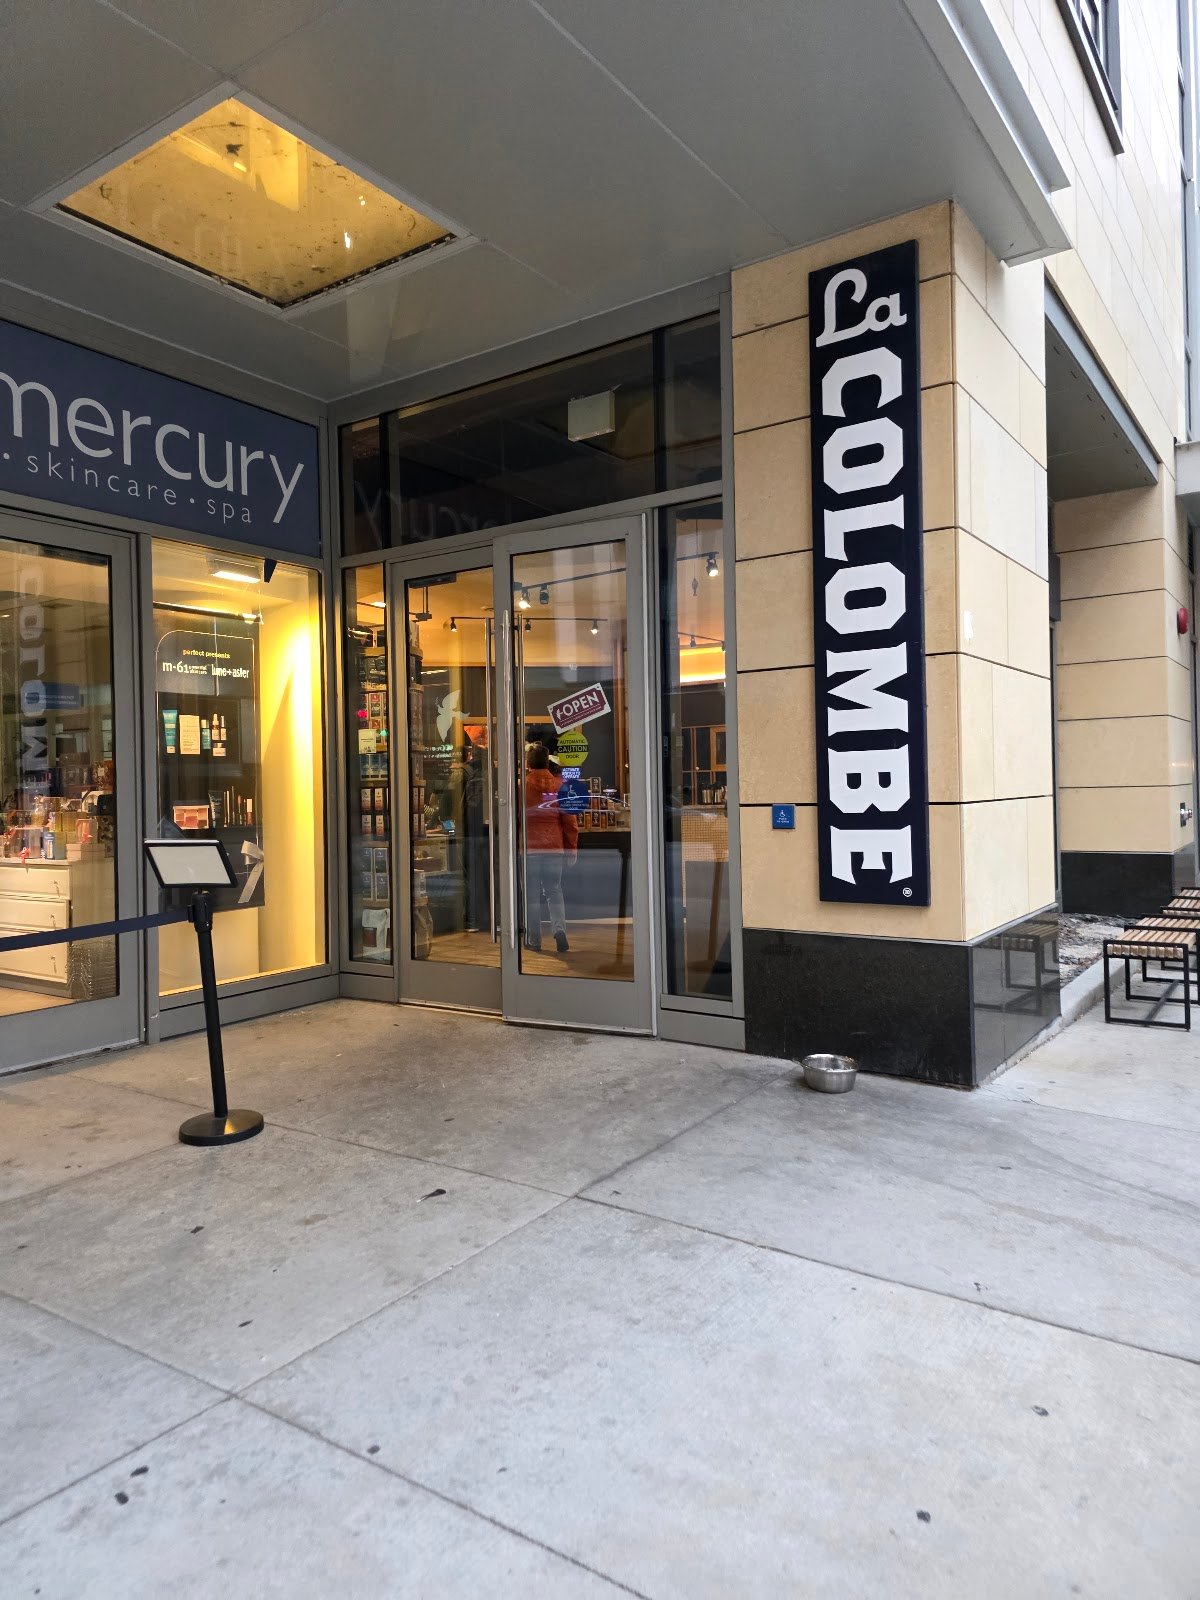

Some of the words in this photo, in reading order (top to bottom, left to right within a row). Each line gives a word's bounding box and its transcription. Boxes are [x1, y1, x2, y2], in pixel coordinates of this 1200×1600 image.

[815, 268, 908, 348] La
[27, 452, 178, 506] skincare
[207, 499, 253, 524] spa
[821, 346, 913, 886] COLOMBE
[562, 691, 600, 717] OPEN
[557, 745, 588, 753] CAUTION
